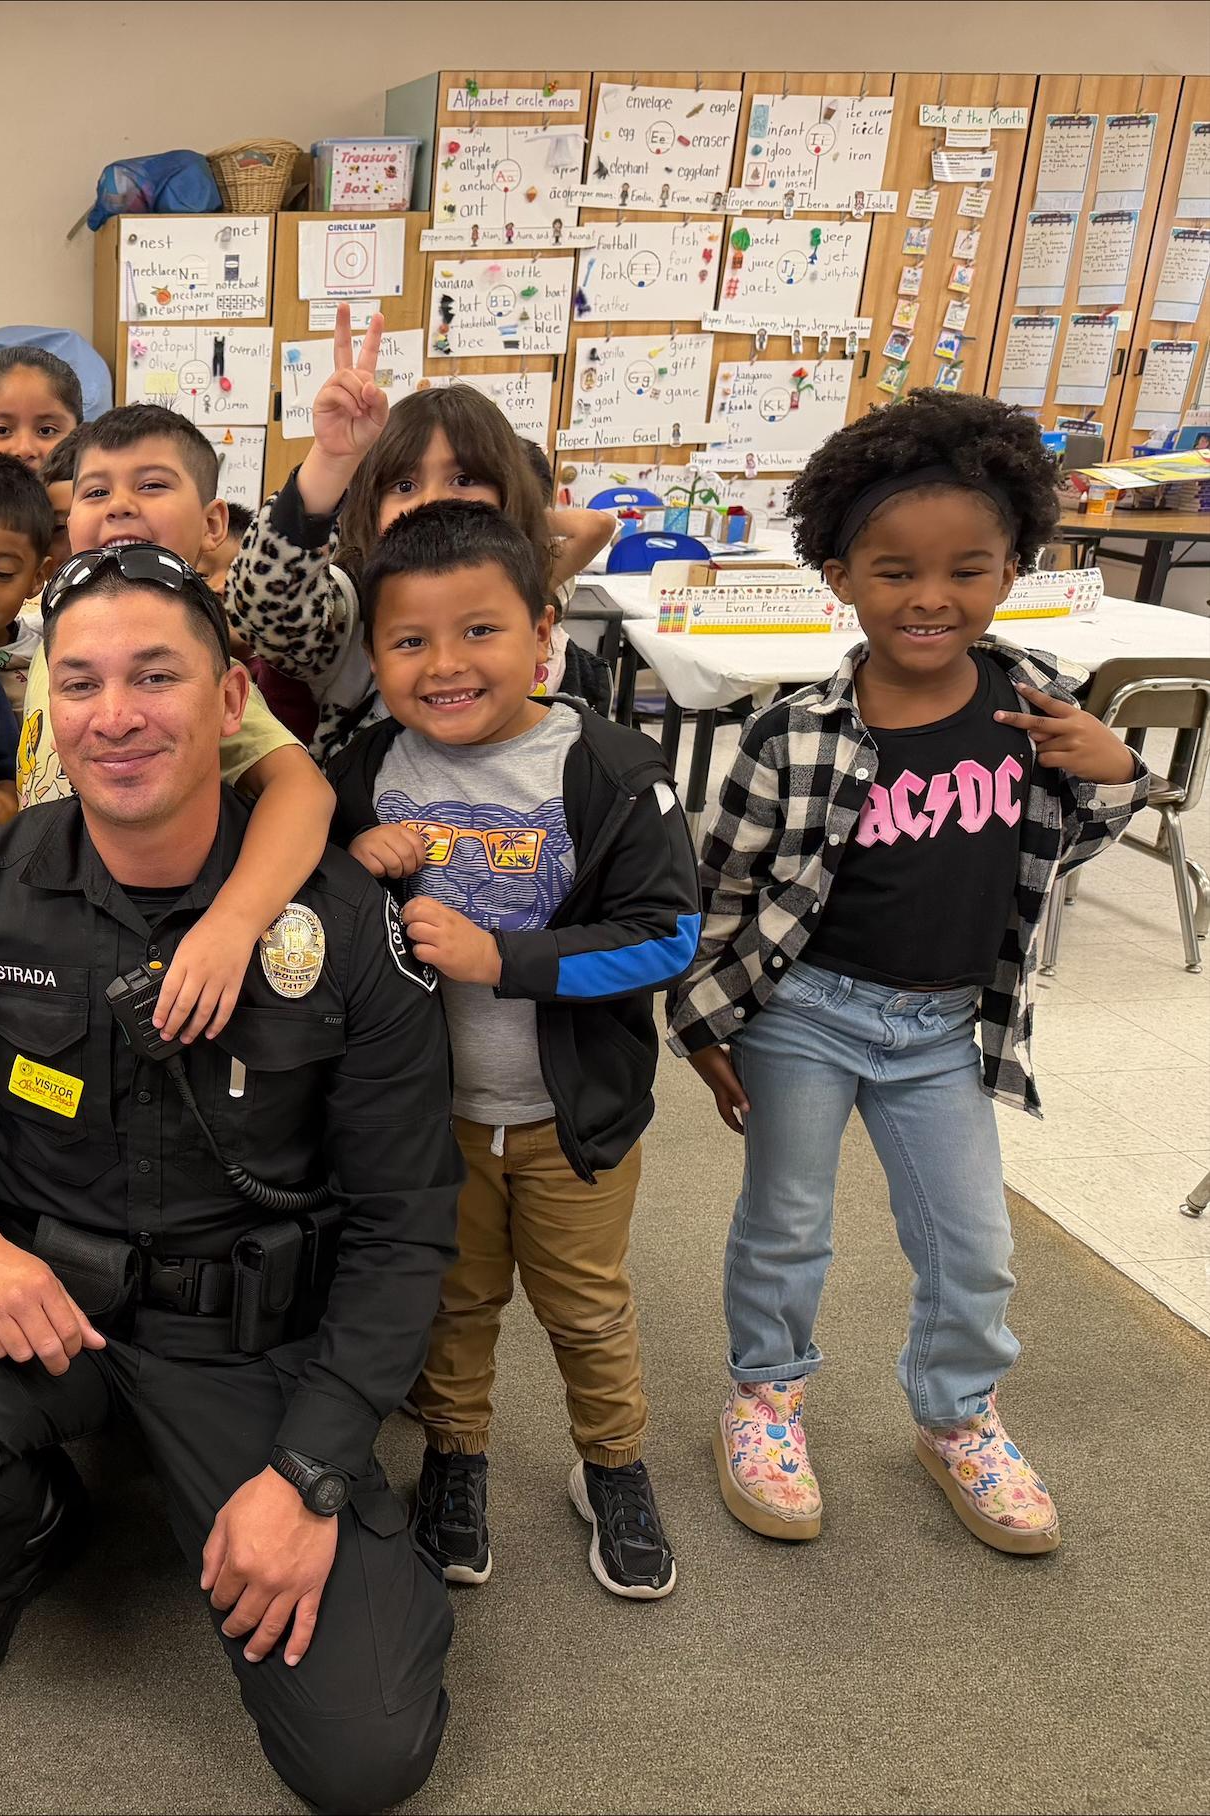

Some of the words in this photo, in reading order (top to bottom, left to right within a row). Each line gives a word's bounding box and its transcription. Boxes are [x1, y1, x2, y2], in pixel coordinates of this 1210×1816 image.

[453, 90, 509, 108] Alphabet
[516, 92, 543, 107] circle
[549, 99, 575, 110] maps
[626, 96, 673, 111] envelope
[710, 100, 736, 117] eagle
[922, 106, 947, 123] Book
[952, 109, 963, 124] of
[967, 110, 983, 124] the
[989, 109, 1024, 124] Month
[618, 127, 635, 141] egg
[768, 122, 805, 137] infant
[464, 141, 491, 157] apple
[692, 135, 730, 148] eraser
[341, 151, 398, 163] Treasure
[766, 142, 791, 162] igloo
[849, 147, 871, 161] iron
[610, 156, 648, 177] elephant
[678, 163, 721, 181] eggplant
[343, 182, 370, 194] Box
[460, 180, 496, 192] anchor
[460, 197, 488, 218] ant
[836, 196, 851, 209] and
[232, 220, 260, 237] net
[328, 224, 358, 232] CIRCLE
[359, 223, 376, 231] MAP
[140, 234, 174, 249] nest
[597, 232, 637, 250] football
[750, 233, 780, 246] jacket
[823, 229, 852, 247] jeep
[824, 249, 849, 265] jet
[133, 262, 177, 277] necklace
[507, 266, 542, 278] bottle
[601, 262, 629, 280] fork
[748, 259, 774, 272] juice
[215, 276, 260, 290] notebook
[434, 278, 474, 289] banana
[742, 278, 777, 296] jacks
[545, 285, 568, 298] boat
[150, 303, 210, 320] newspaper
[458, 295, 482, 313] bat
[222, 310, 243, 318] nine
[534, 304, 562, 321] bell
[535, 322, 561, 334] blue
[458, 333, 484, 348] bee
[670, 340, 706, 356] guitar
[283, 362, 311, 376] mug
[671, 357, 697, 376] gift
[393, 371, 414, 386] map
[597, 368, 615, 387] girl
[813, 367, 845, 382] kite
[506, 376, 531, 394] cat
[731, 383, 758, 398] kettle
[595, 390, 621, 412] goat
[664, 388, 700, 405] game
[286, 407, 313, 423] mop
[559, 432, 589, 447] Proper
[594, 429, 625, 445] Noun:
[632, 428, 661, 443] Gael
[581, 464, 604, 477] hat
[655, 466, 690, 484] horse
[726, 603, 754, 613] Evan
[761, 602, 790, 612] Perez
[390, 921, 407, 955] LOS
[273, 970, 311, 981] POLICE
[35, 1076, 74, 1099] VISITOR
